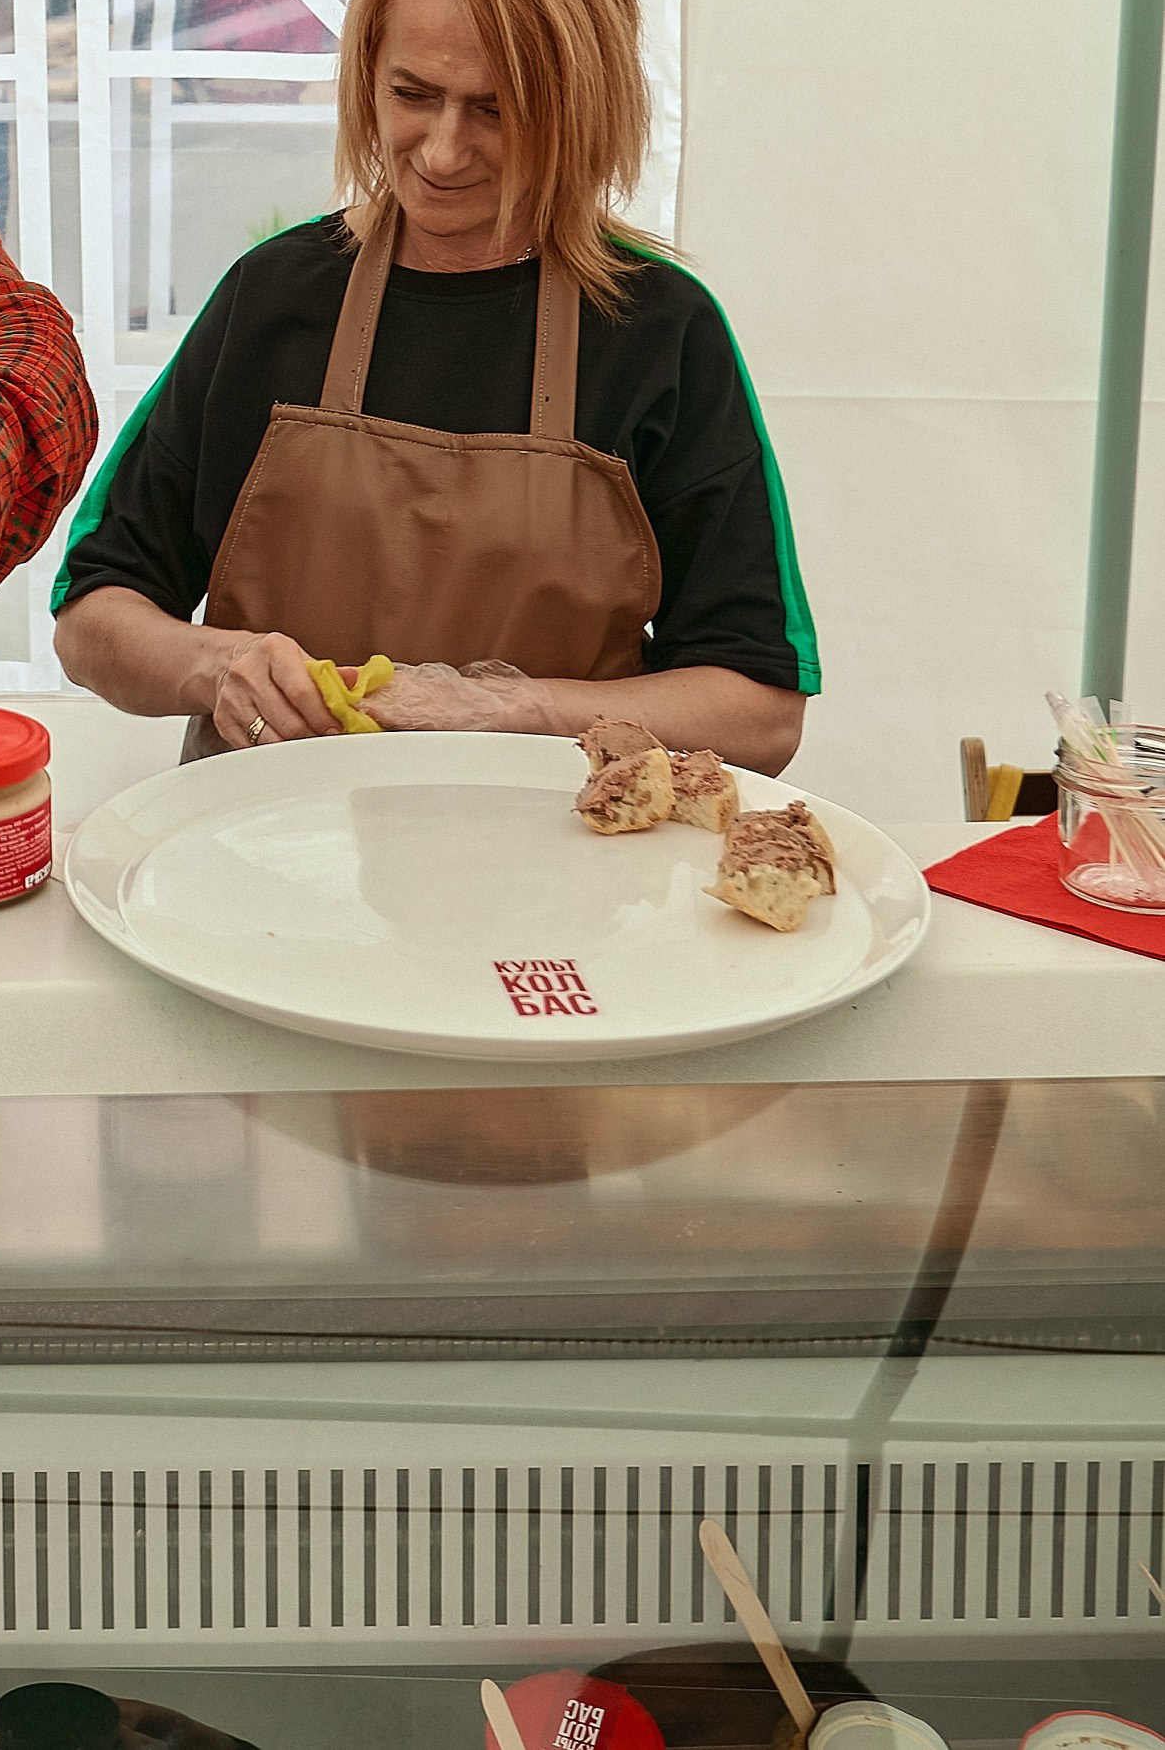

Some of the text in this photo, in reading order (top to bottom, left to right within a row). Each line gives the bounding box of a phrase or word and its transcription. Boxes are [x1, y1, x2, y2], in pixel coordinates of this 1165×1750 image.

[493, 959, 576, 973] КУЛЬТ
[501, 973, 587, 993] КОЛ
[510, 993, 598, 1016] БАС
[564, 1699, 605, 1729] БАС
[558, 1717, 600, 1746] КОЛ
